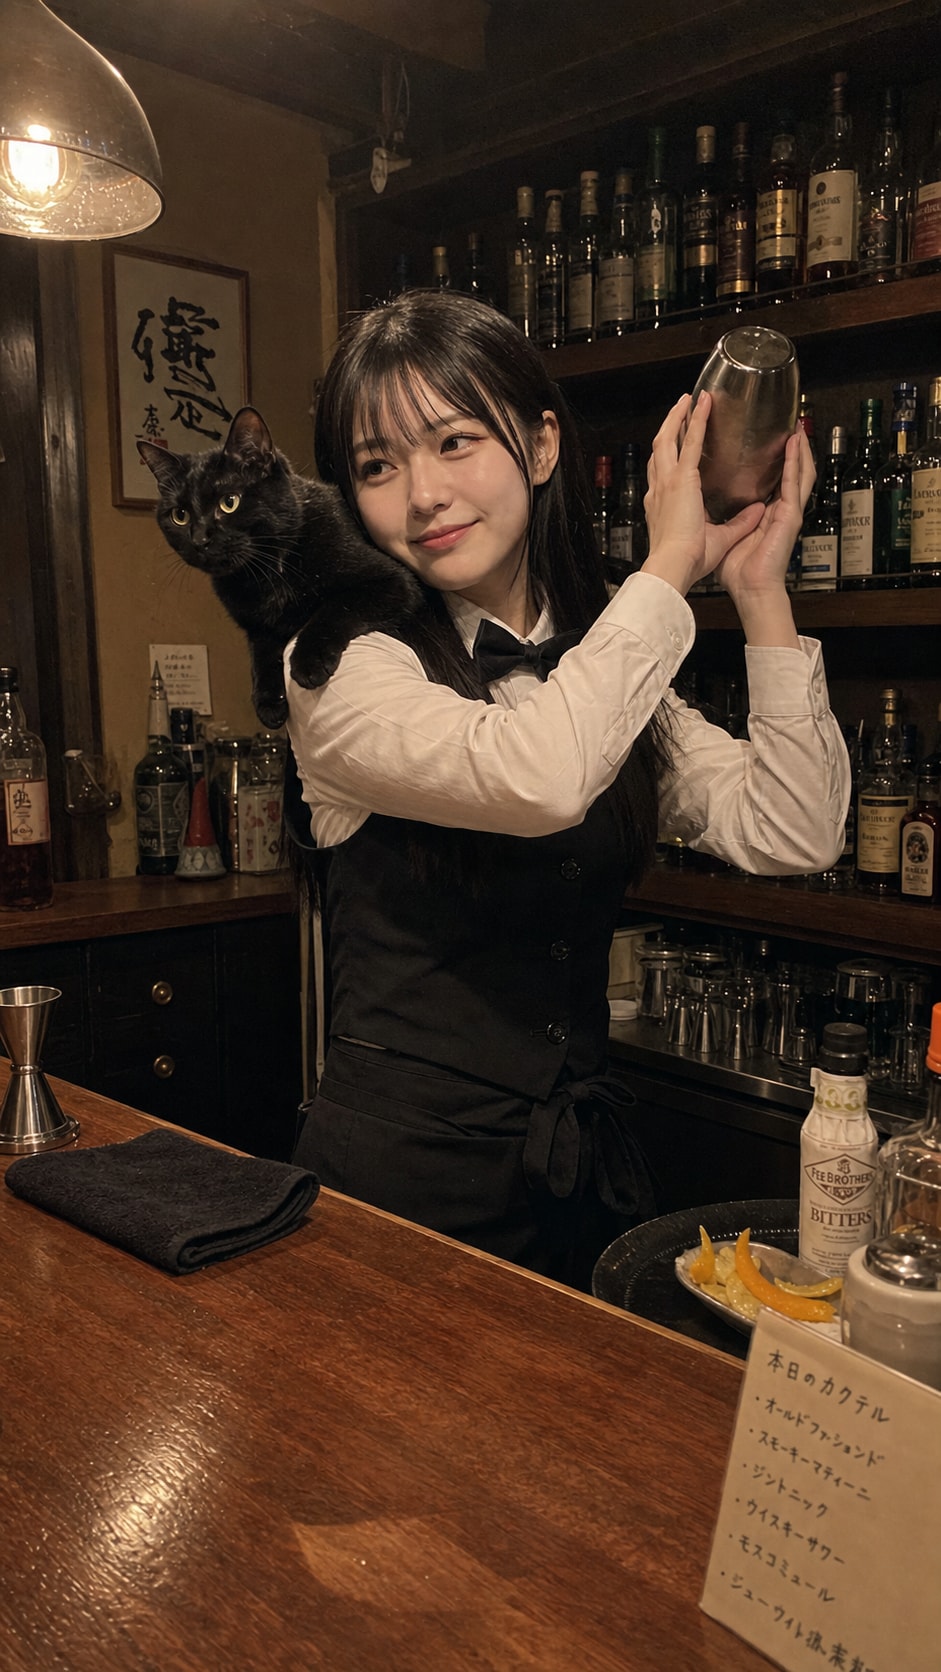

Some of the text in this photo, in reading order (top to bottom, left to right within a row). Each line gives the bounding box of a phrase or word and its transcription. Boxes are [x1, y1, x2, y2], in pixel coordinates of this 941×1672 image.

[811, 1167, 826, 1182] FEE
[810, 1207, 872, 1227] BITTERS
[767, 1349, 890, 1423] 本日のカクテル
[752, 1464, 828, 1518] ジントニック
[739, 1535, 835, 1602] モスコミュール
